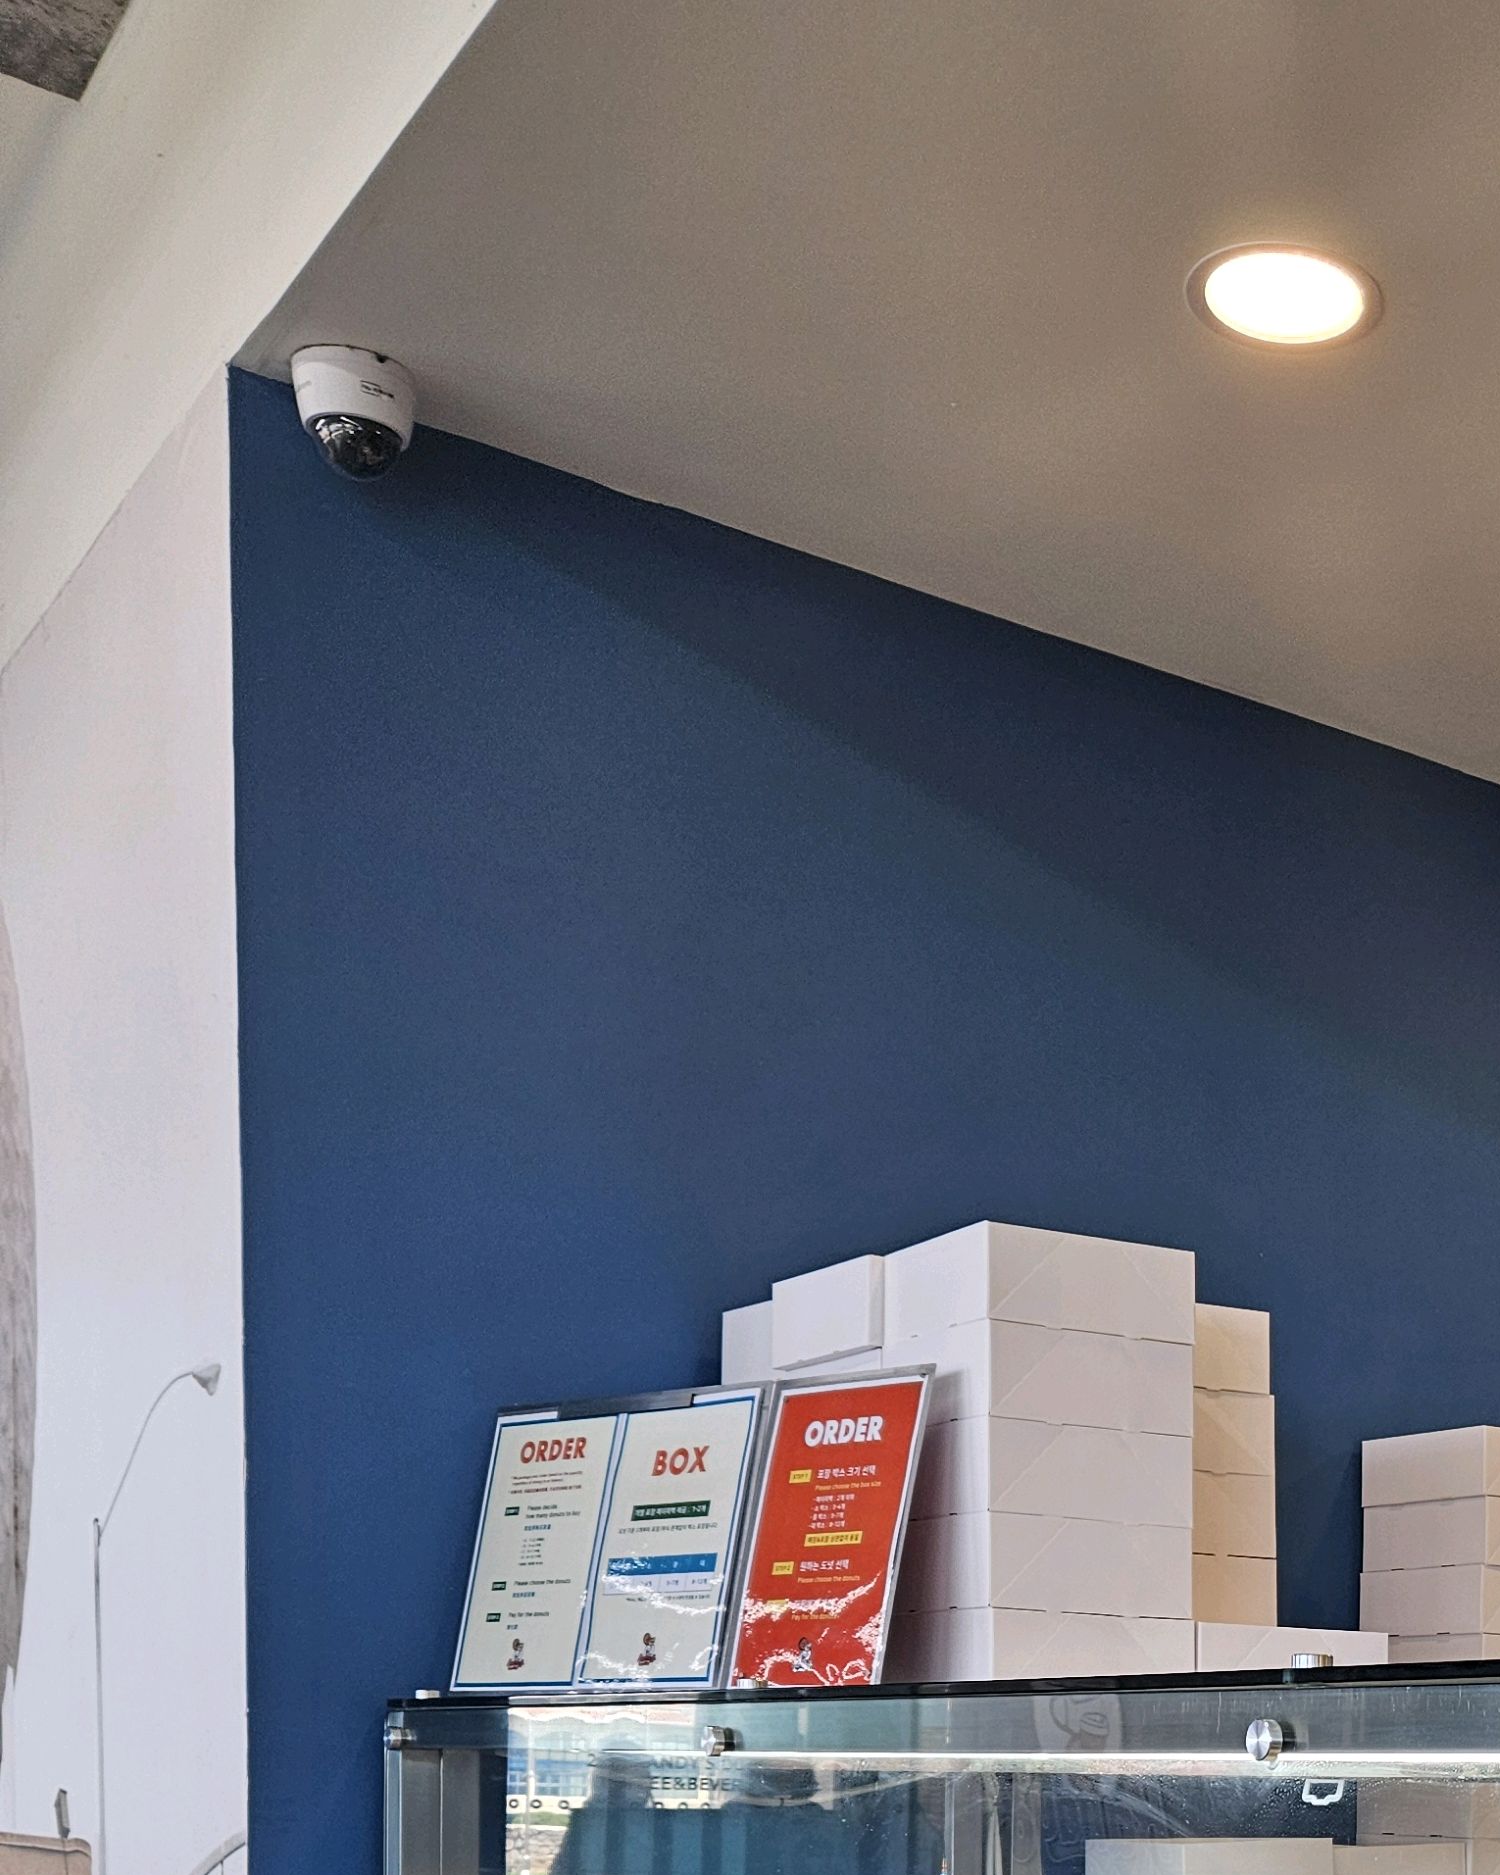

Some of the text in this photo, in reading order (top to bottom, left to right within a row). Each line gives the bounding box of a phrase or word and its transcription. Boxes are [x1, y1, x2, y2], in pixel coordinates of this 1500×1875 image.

[804, 1415, 883, 1448] ORDER
[520, 1437, 587, 1464] ORDER
[652, 1445, 710, 1476] BOX
[846, 1466, 861, 1476] 크기
